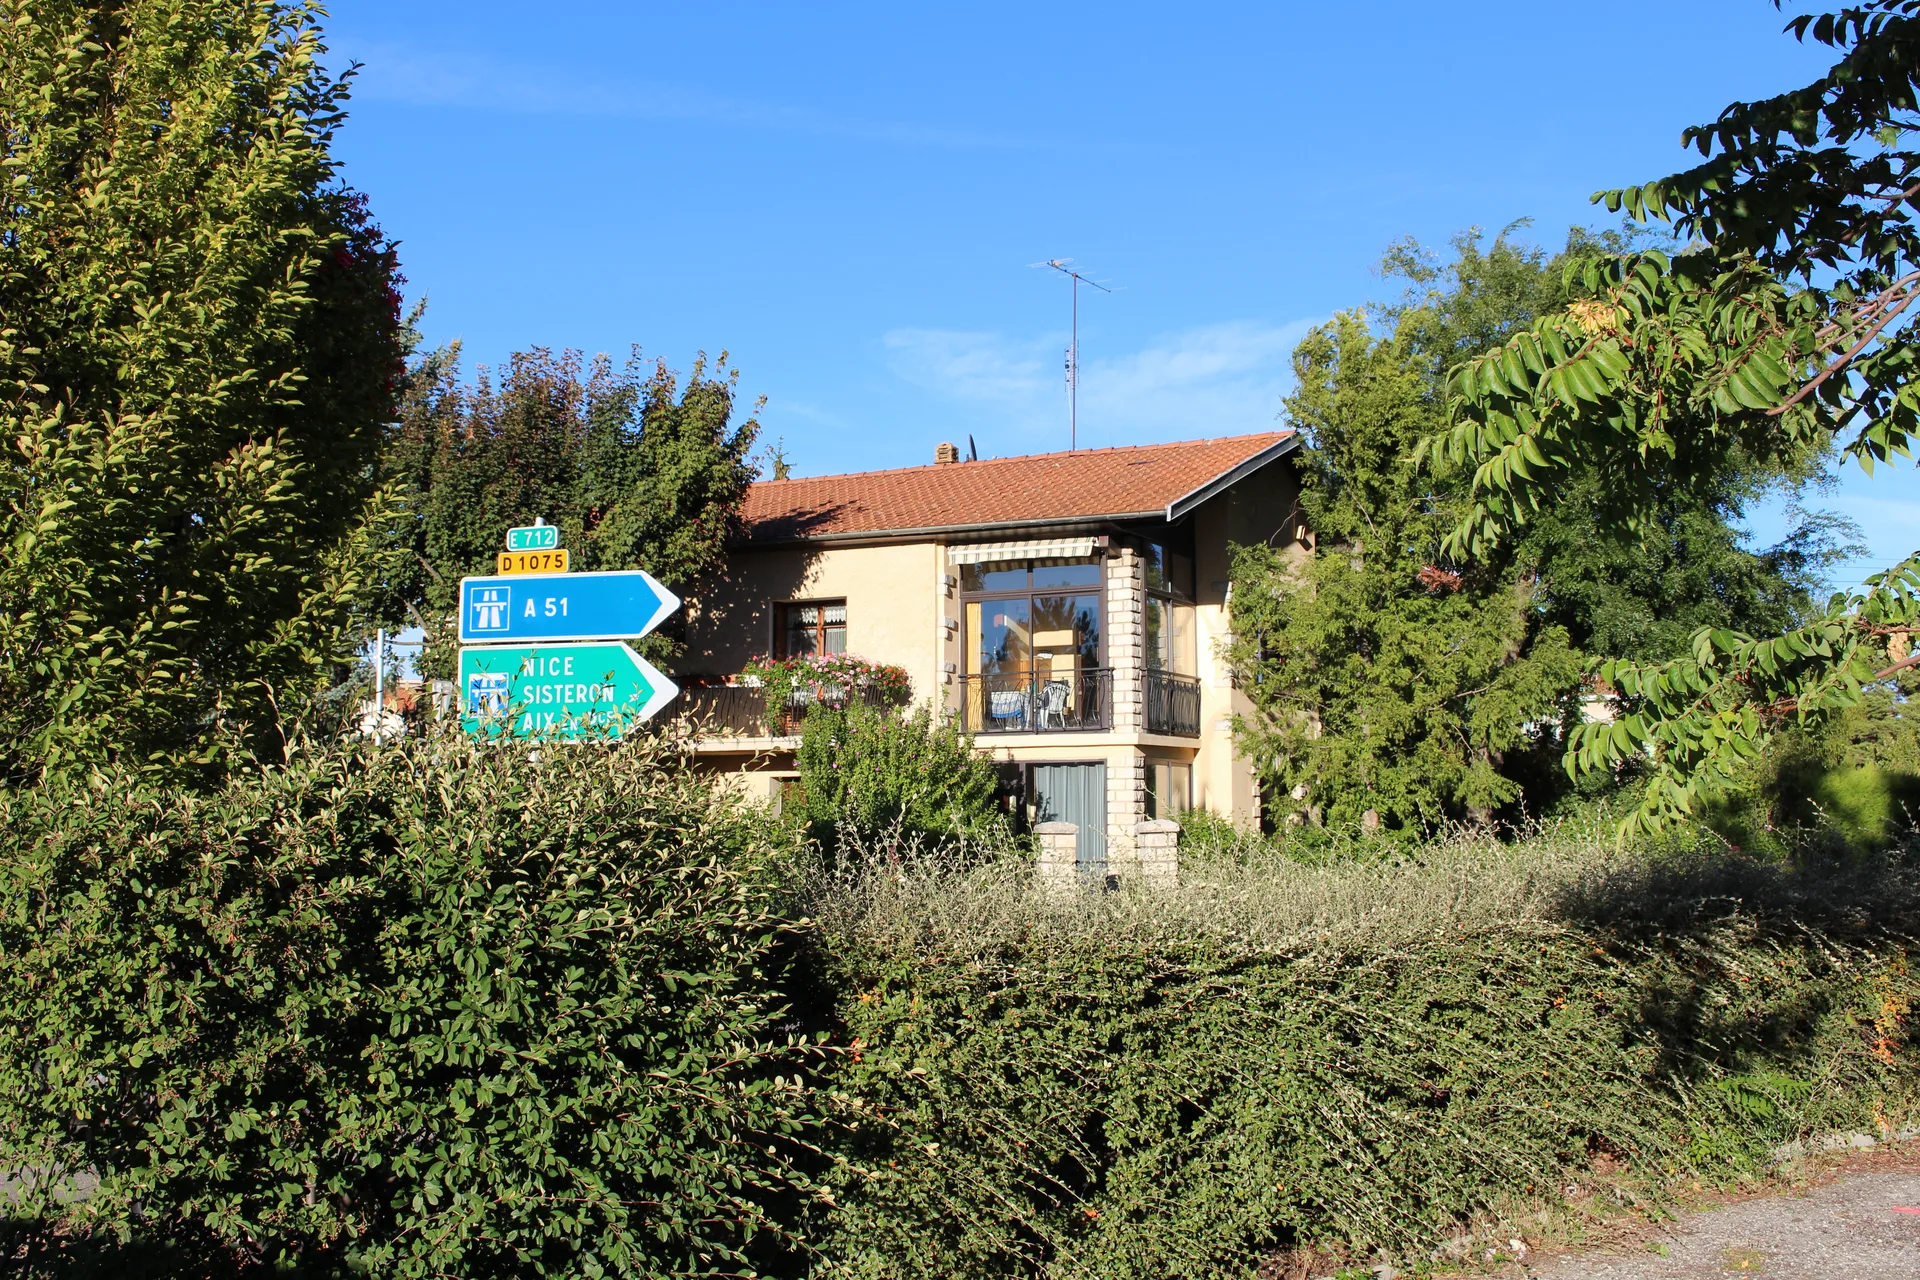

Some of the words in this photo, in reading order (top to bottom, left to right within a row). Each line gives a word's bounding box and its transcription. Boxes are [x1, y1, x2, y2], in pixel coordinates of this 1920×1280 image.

[510, 532, 518, 548] E
[524, 530, 553, 546] 712
[503, 557, 512, 571] D
[519, 554, 563, 570] 1075
[524, 598, 536, 618] A
[544, 597, 568, 617] 51
[522, 656, 574, 677] NICE
[522, 683, 614, 704] SISTERON
[522, 712, 555, 731] AIX
